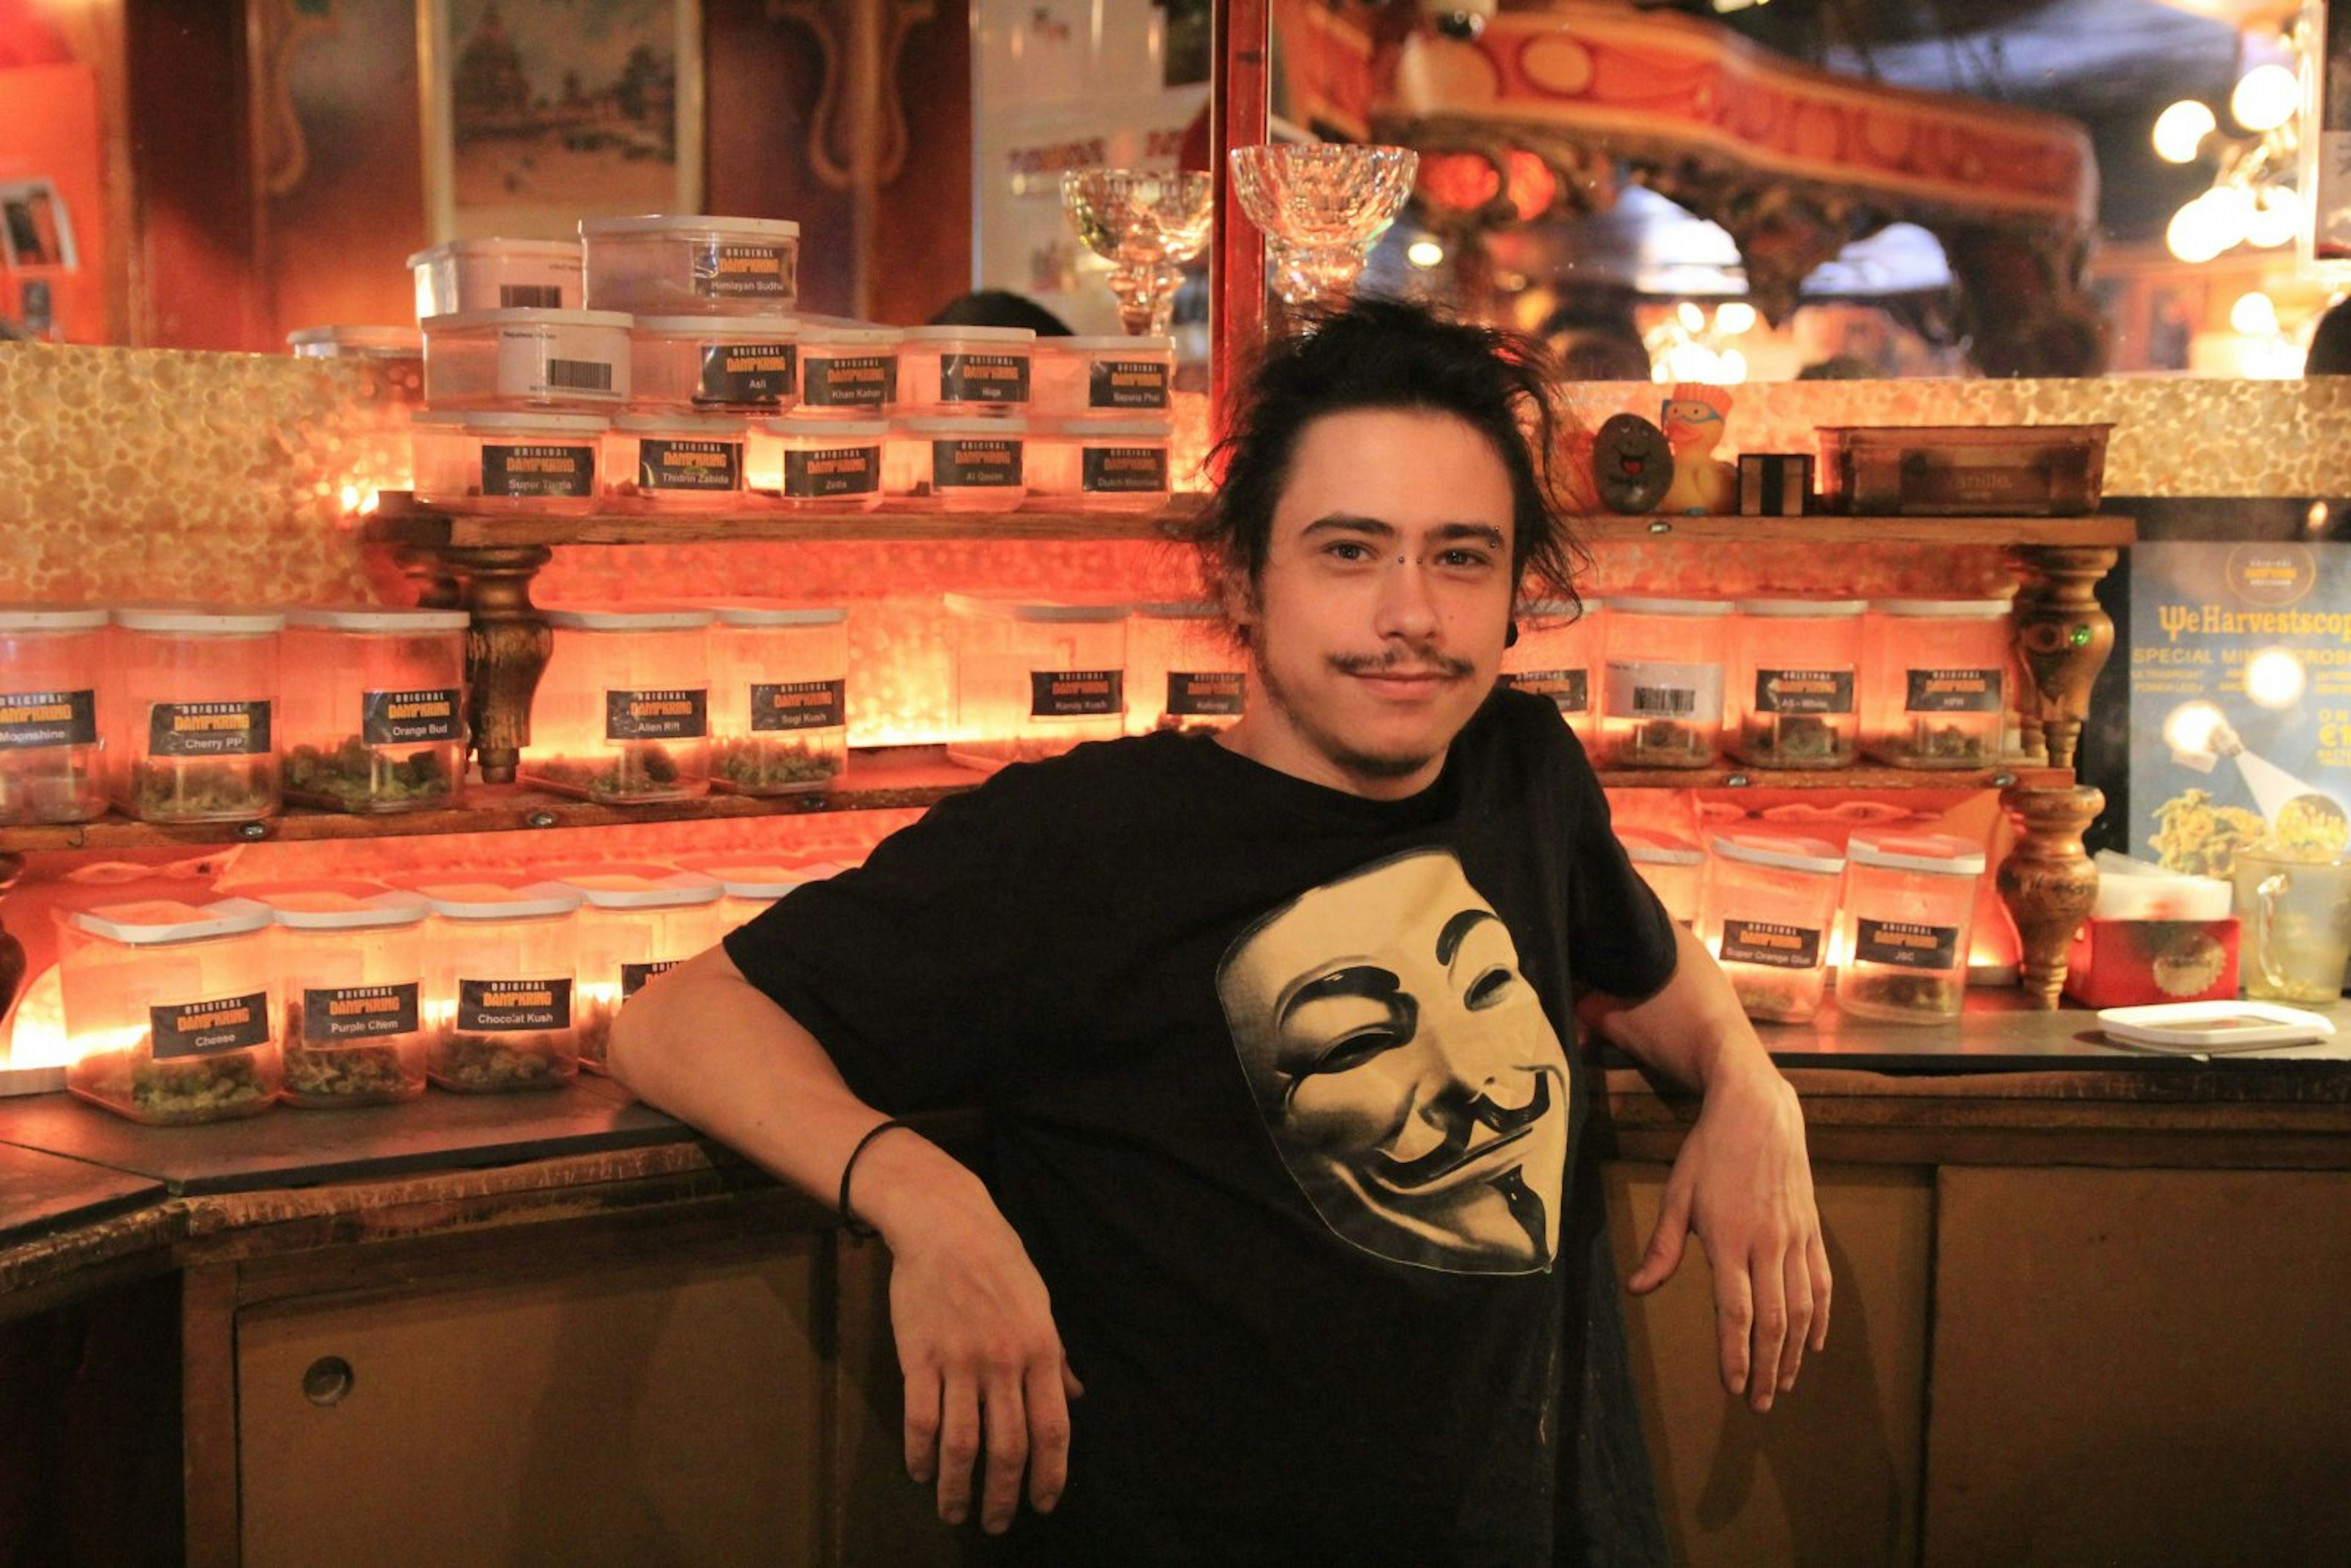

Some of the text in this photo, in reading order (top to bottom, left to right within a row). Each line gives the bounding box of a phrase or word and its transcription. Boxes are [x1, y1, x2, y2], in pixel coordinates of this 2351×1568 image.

[733, 347, 779, 356] ORIGINAL
[2132, 647, 2213, 664] SPECIAL
[396, 692, 444, 702] ORIGINAL
[182, 704, 242, 715] ORIGINAL
[393, 724, 448, 737] Orange Bud
[639, 722, 662, 731] Alien
[186, 737, 243, 751] Cherry PP
[491, 981, 546, 991] ORIGINAL
[337, 987, 392, 999] ORIGINAL
[185, 999, 242, 1015] ORIGINAL
[527, 1013, 553, 1023] Kush
[331, 1019, 399, 1034] Purple Chem
[195, 1033, 236, 1047] Cheese
